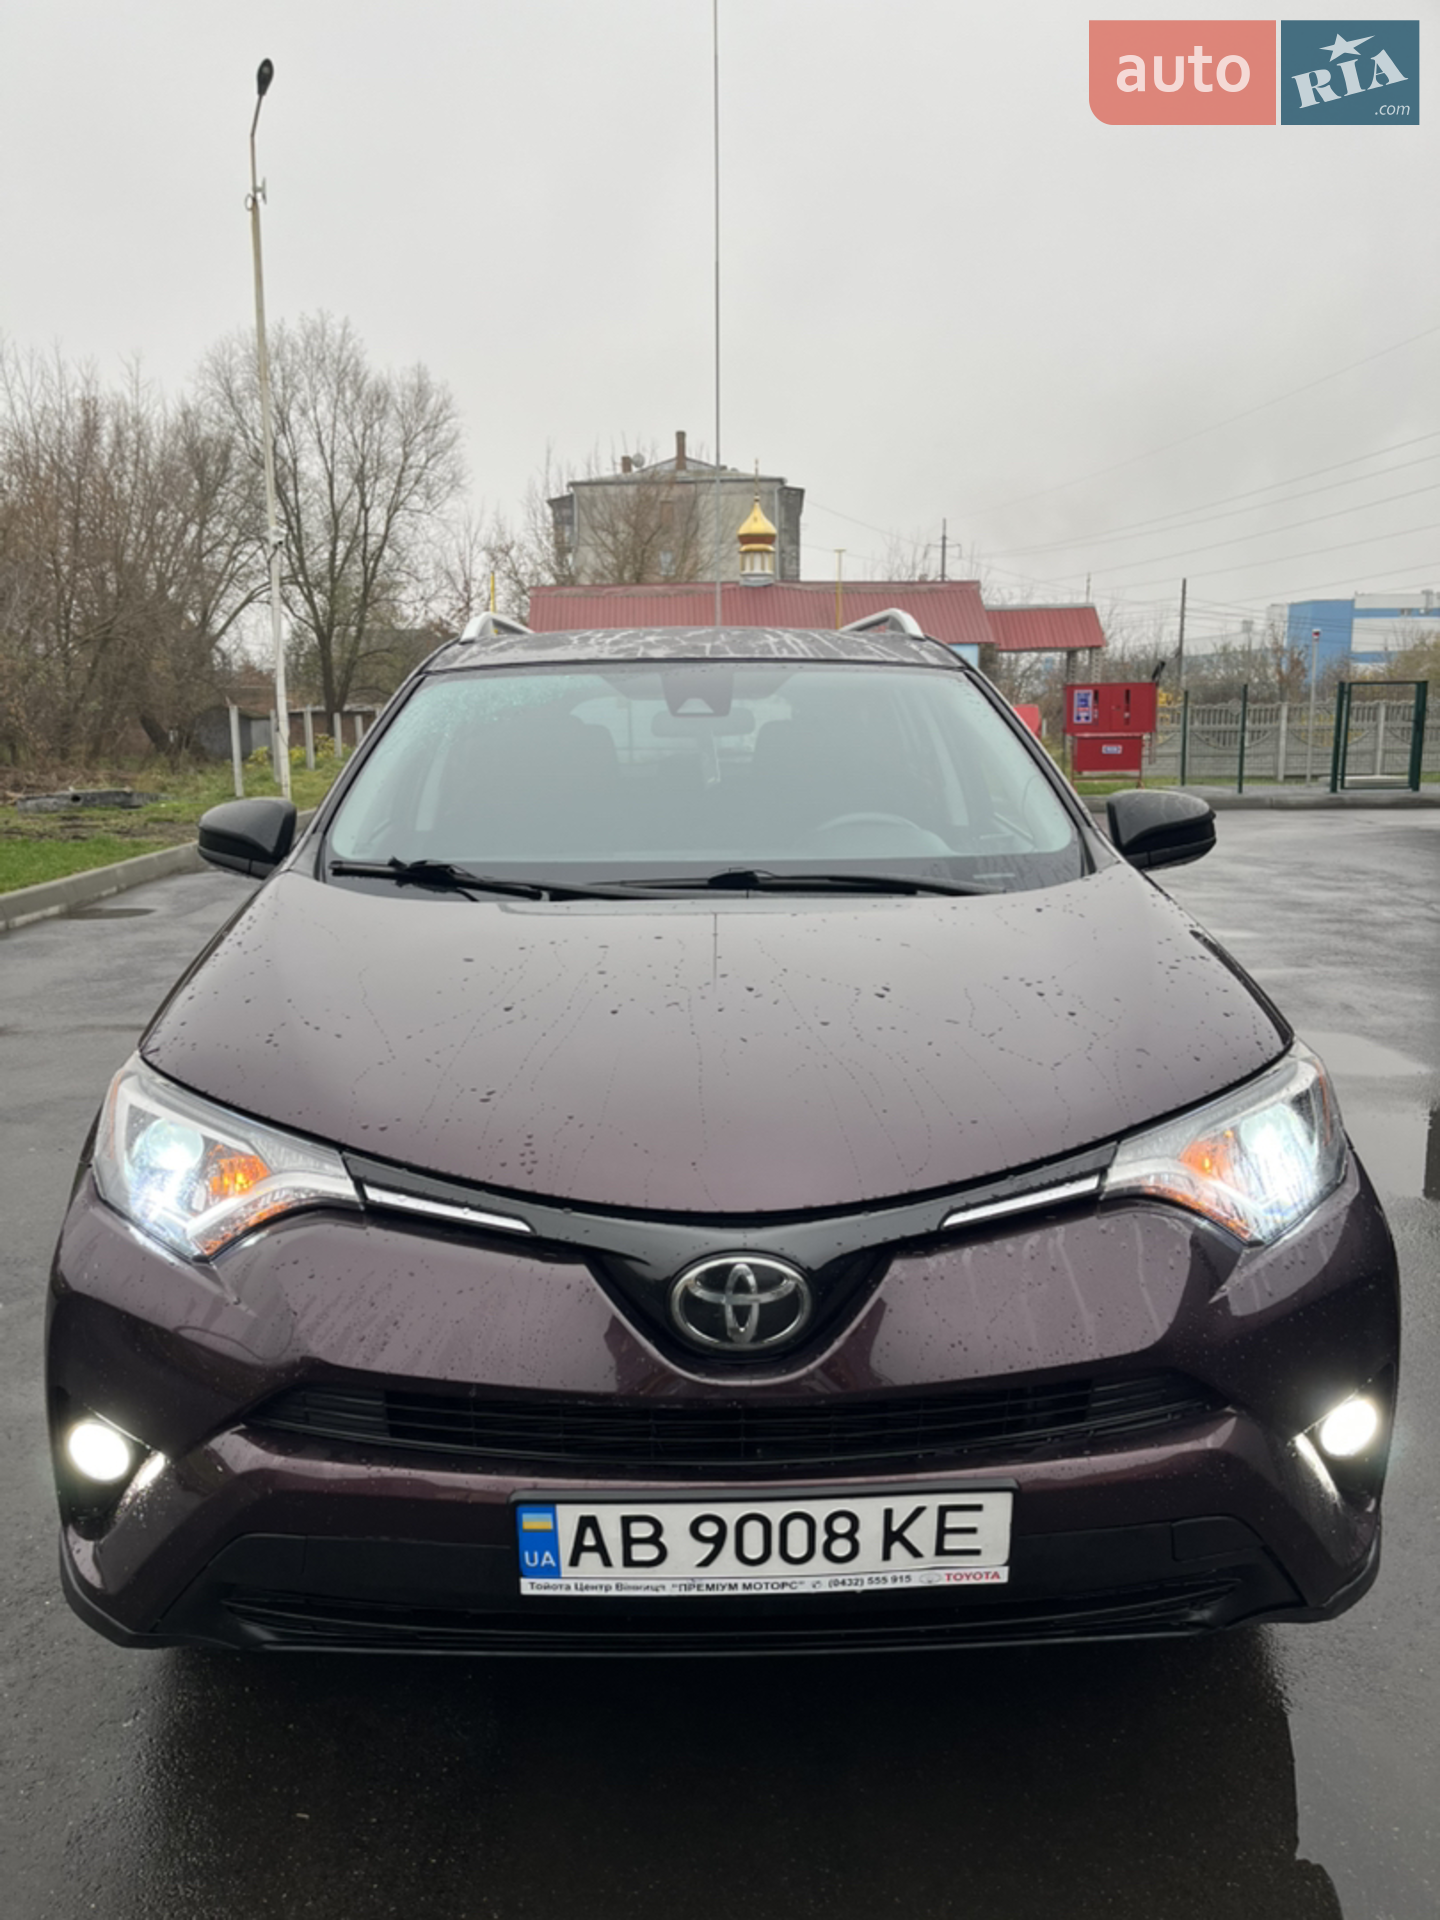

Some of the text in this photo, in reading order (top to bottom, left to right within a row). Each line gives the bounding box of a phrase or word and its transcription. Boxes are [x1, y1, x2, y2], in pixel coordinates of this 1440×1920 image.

[568, 1504, 984, 1568] AB 9008 KE
[524, 1551, 556, 1568] UA
[528, 1581, 571, 1591] Тойота
[574, 1582, 612, 1593] Центр
[828, 1577, 864, 1588] (0432)
[867, 1576, 888, 1585] 555
[890, 1574, 912, 1584] 915
[944, 1571, 1001, 1582] TOYOTA
